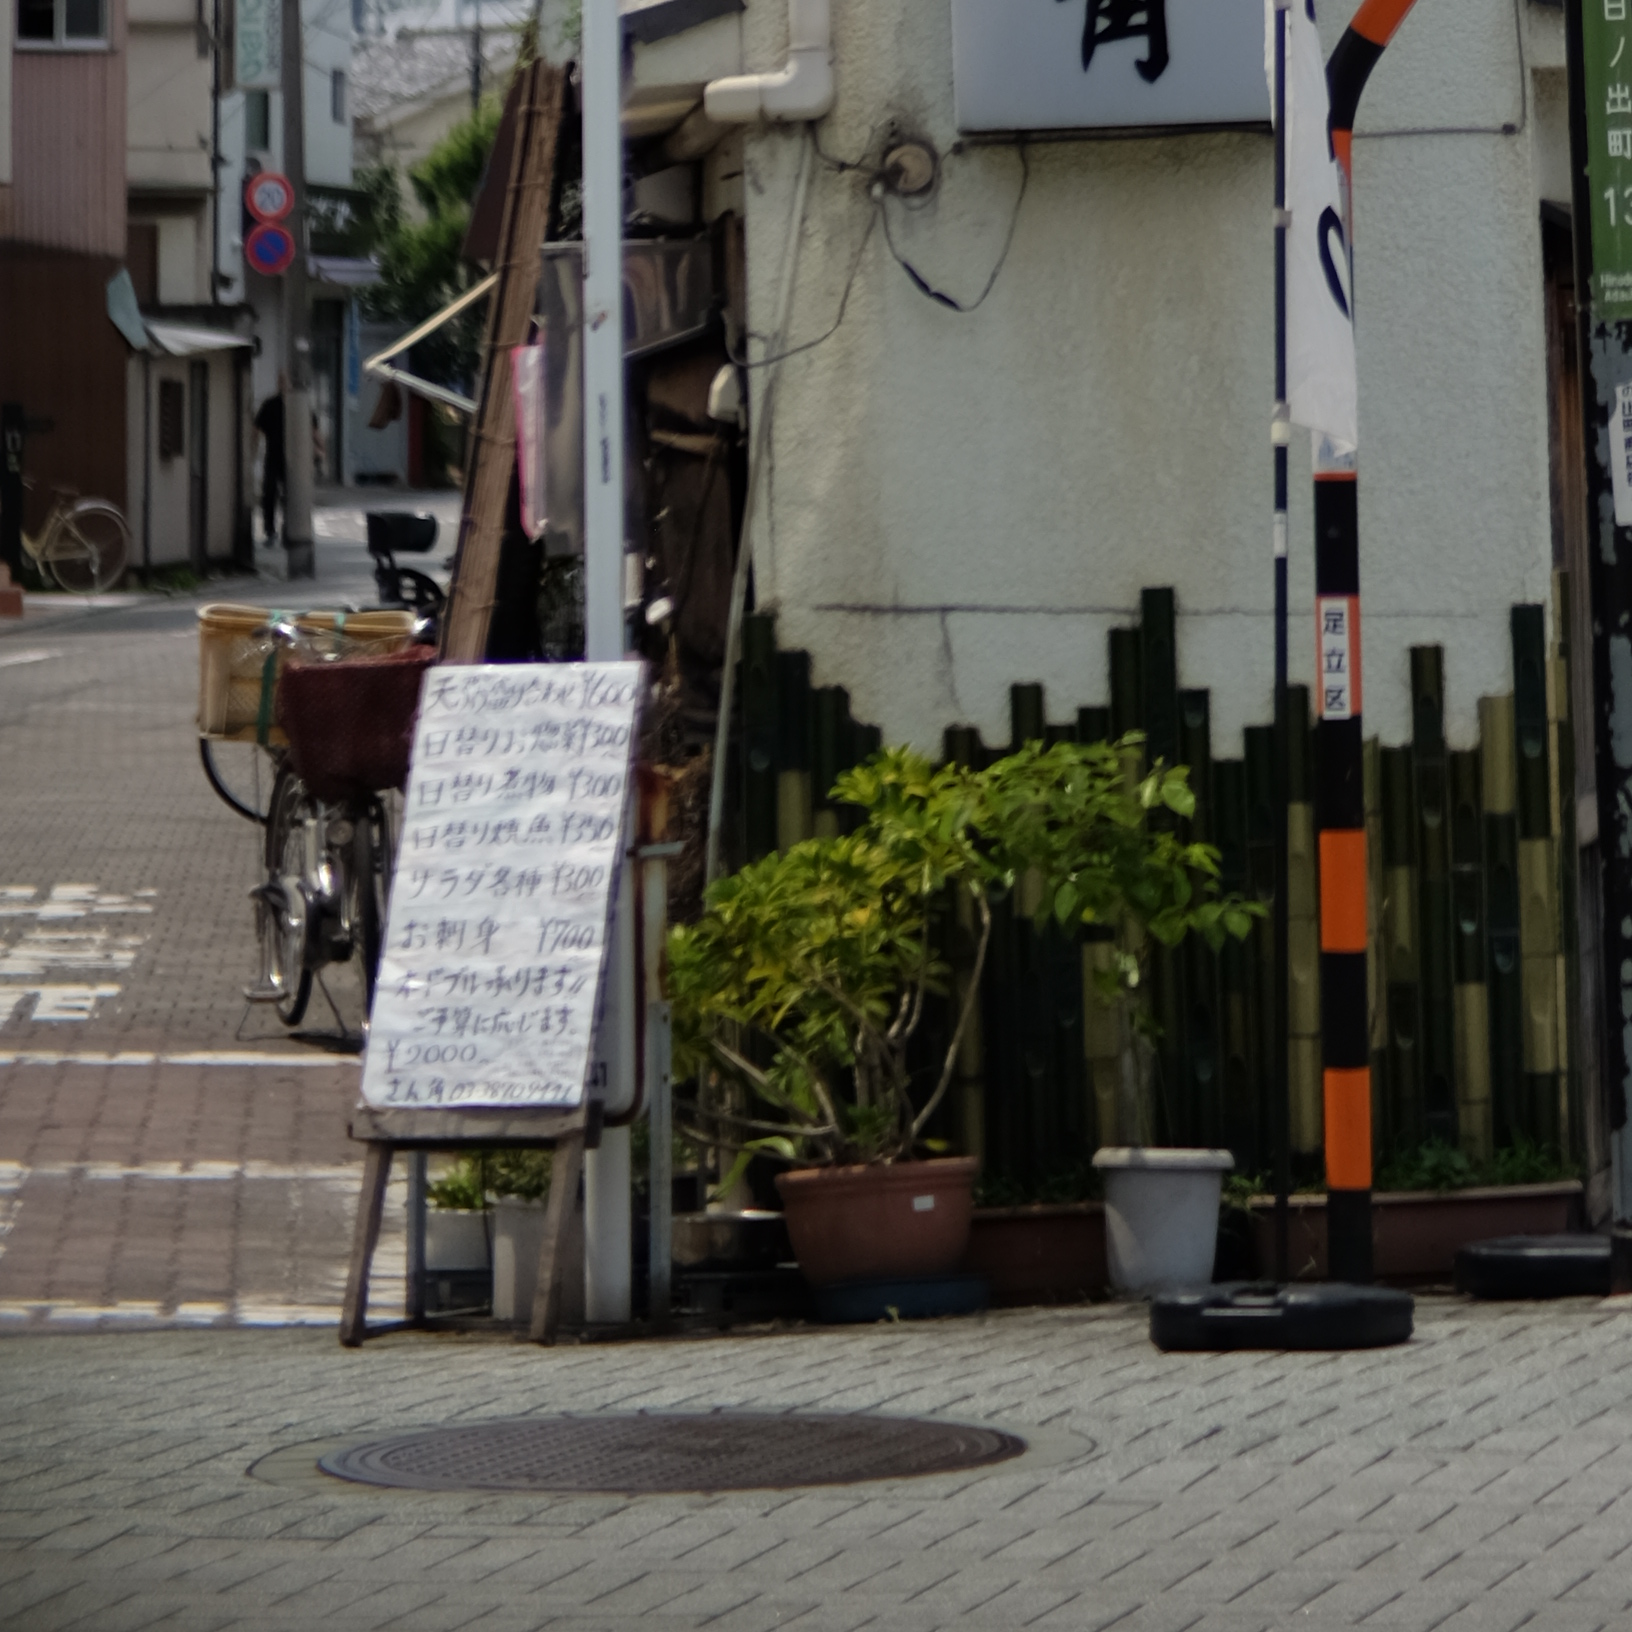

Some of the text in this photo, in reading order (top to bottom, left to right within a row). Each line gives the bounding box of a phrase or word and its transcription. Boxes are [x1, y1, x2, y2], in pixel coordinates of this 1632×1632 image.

[1323, 610, 1346, 710] 足立区
[401, 914, 500, 955] お刺身
